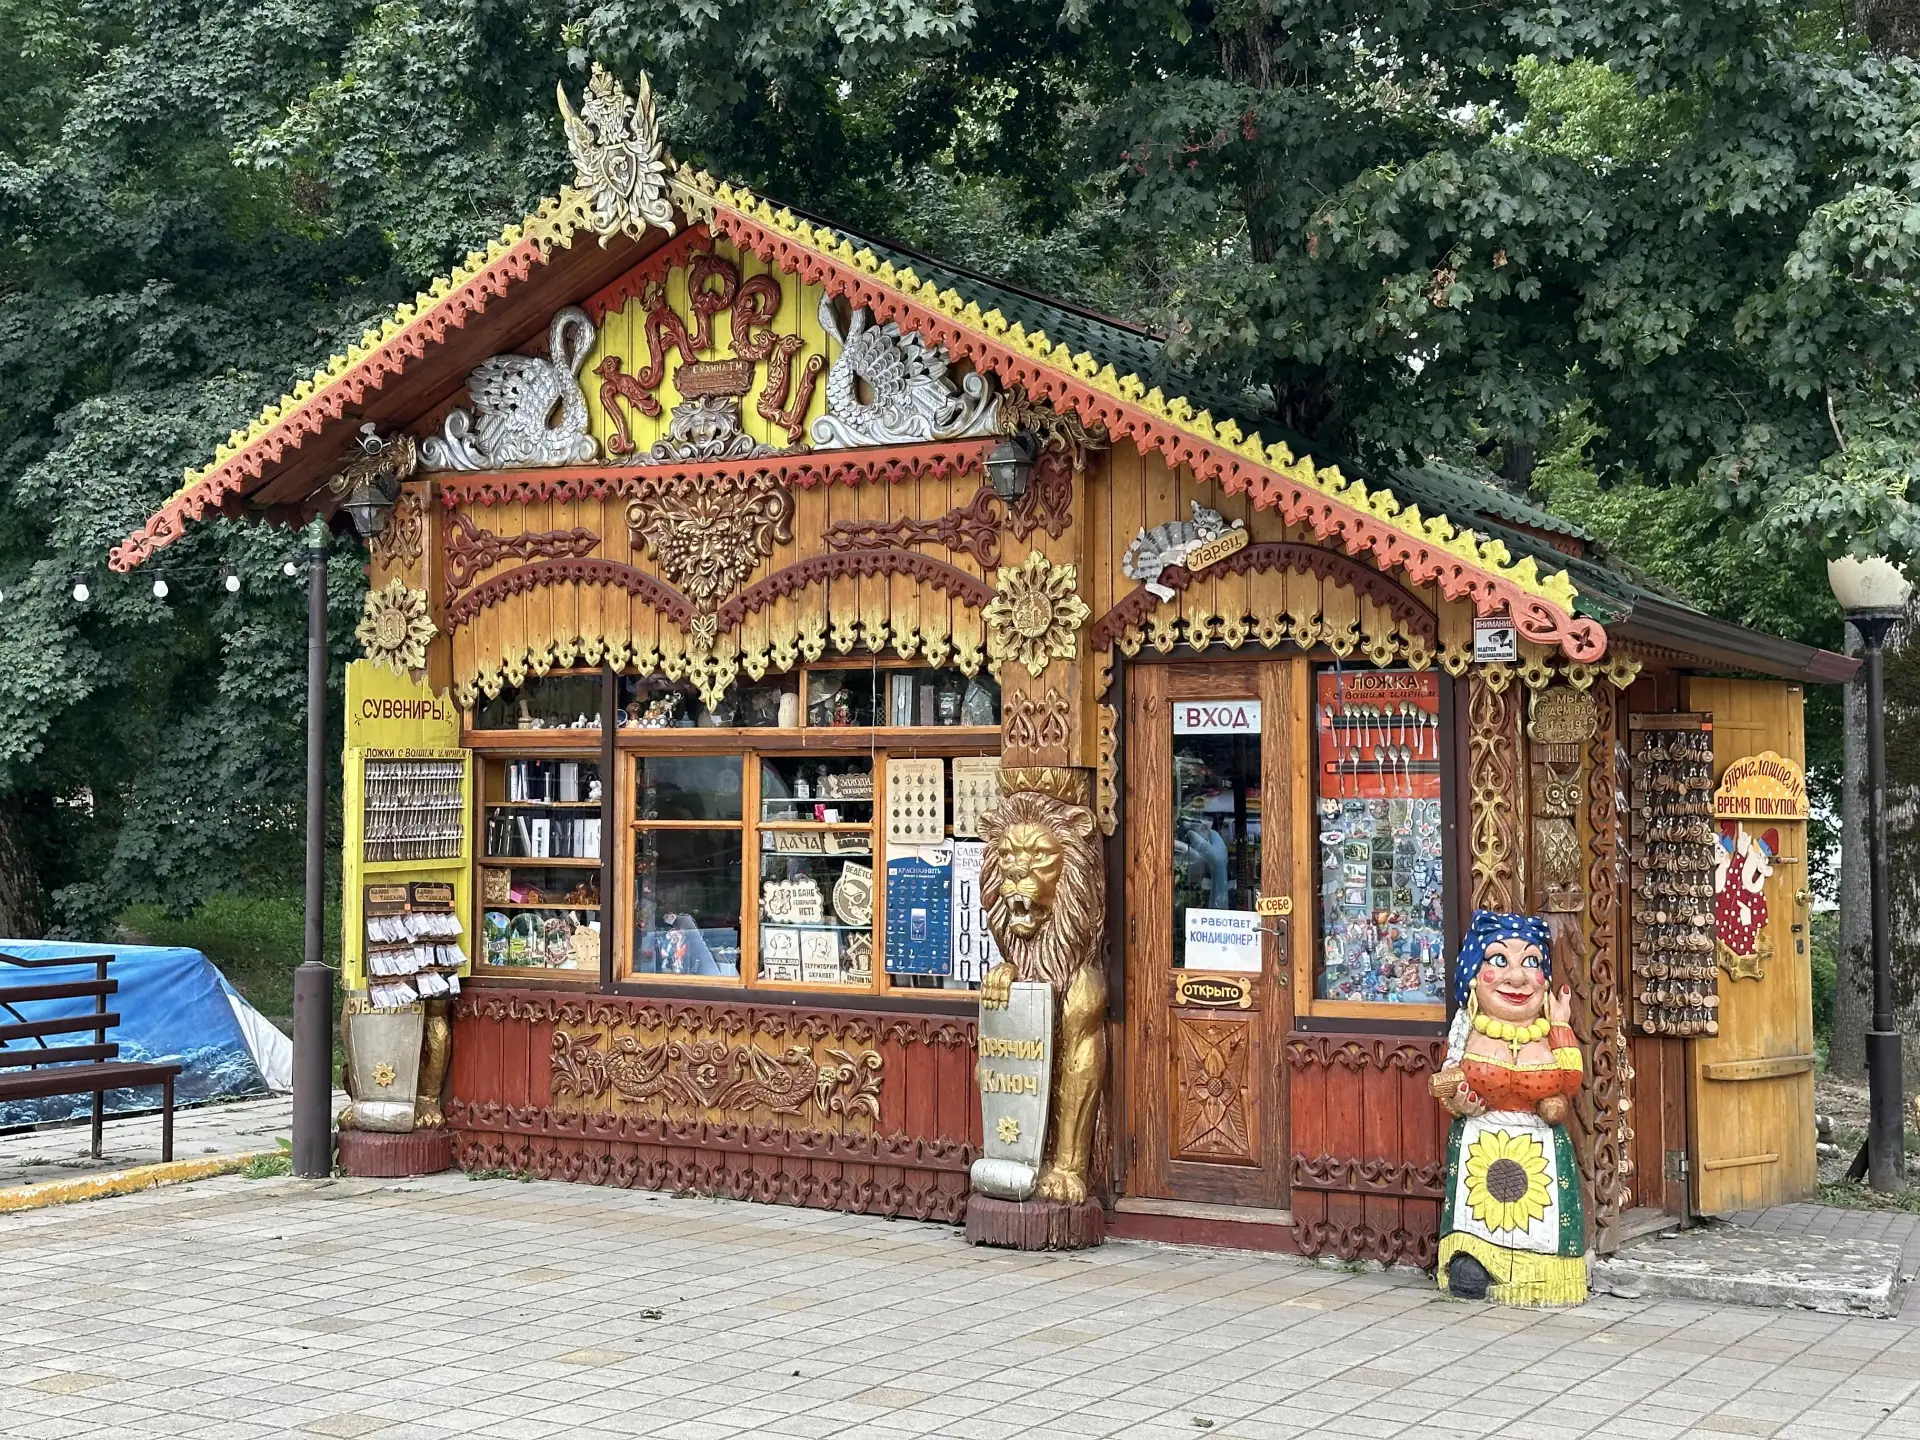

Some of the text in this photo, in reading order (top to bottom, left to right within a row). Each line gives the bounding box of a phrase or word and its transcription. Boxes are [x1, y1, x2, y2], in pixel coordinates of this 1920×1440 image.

[1188, 535, 1242, 567] Ларец
[1476, 620, 1513, 629] ВНИМАНИЕ
[1349, 675, 1420, 690] ЛОЖКА
[1556, 694, 1577, 704] МЫ
[1574, 705, 1593, 715] ВАС
[1186, 706, 1250, 728] ВХОД
[364, 748, 395, 758] ЛОЖКИ
[1717, 796, 1798, 815] ВРЕМЯ ПОКУПОК
[779, 836, 822, 851] ДАЧА
[957, 847, 984, 857] СЛАВЯ
[962, 858, 984, 867] БРАС
[1183, 984, 1239, 998] ОТКРЫТО
